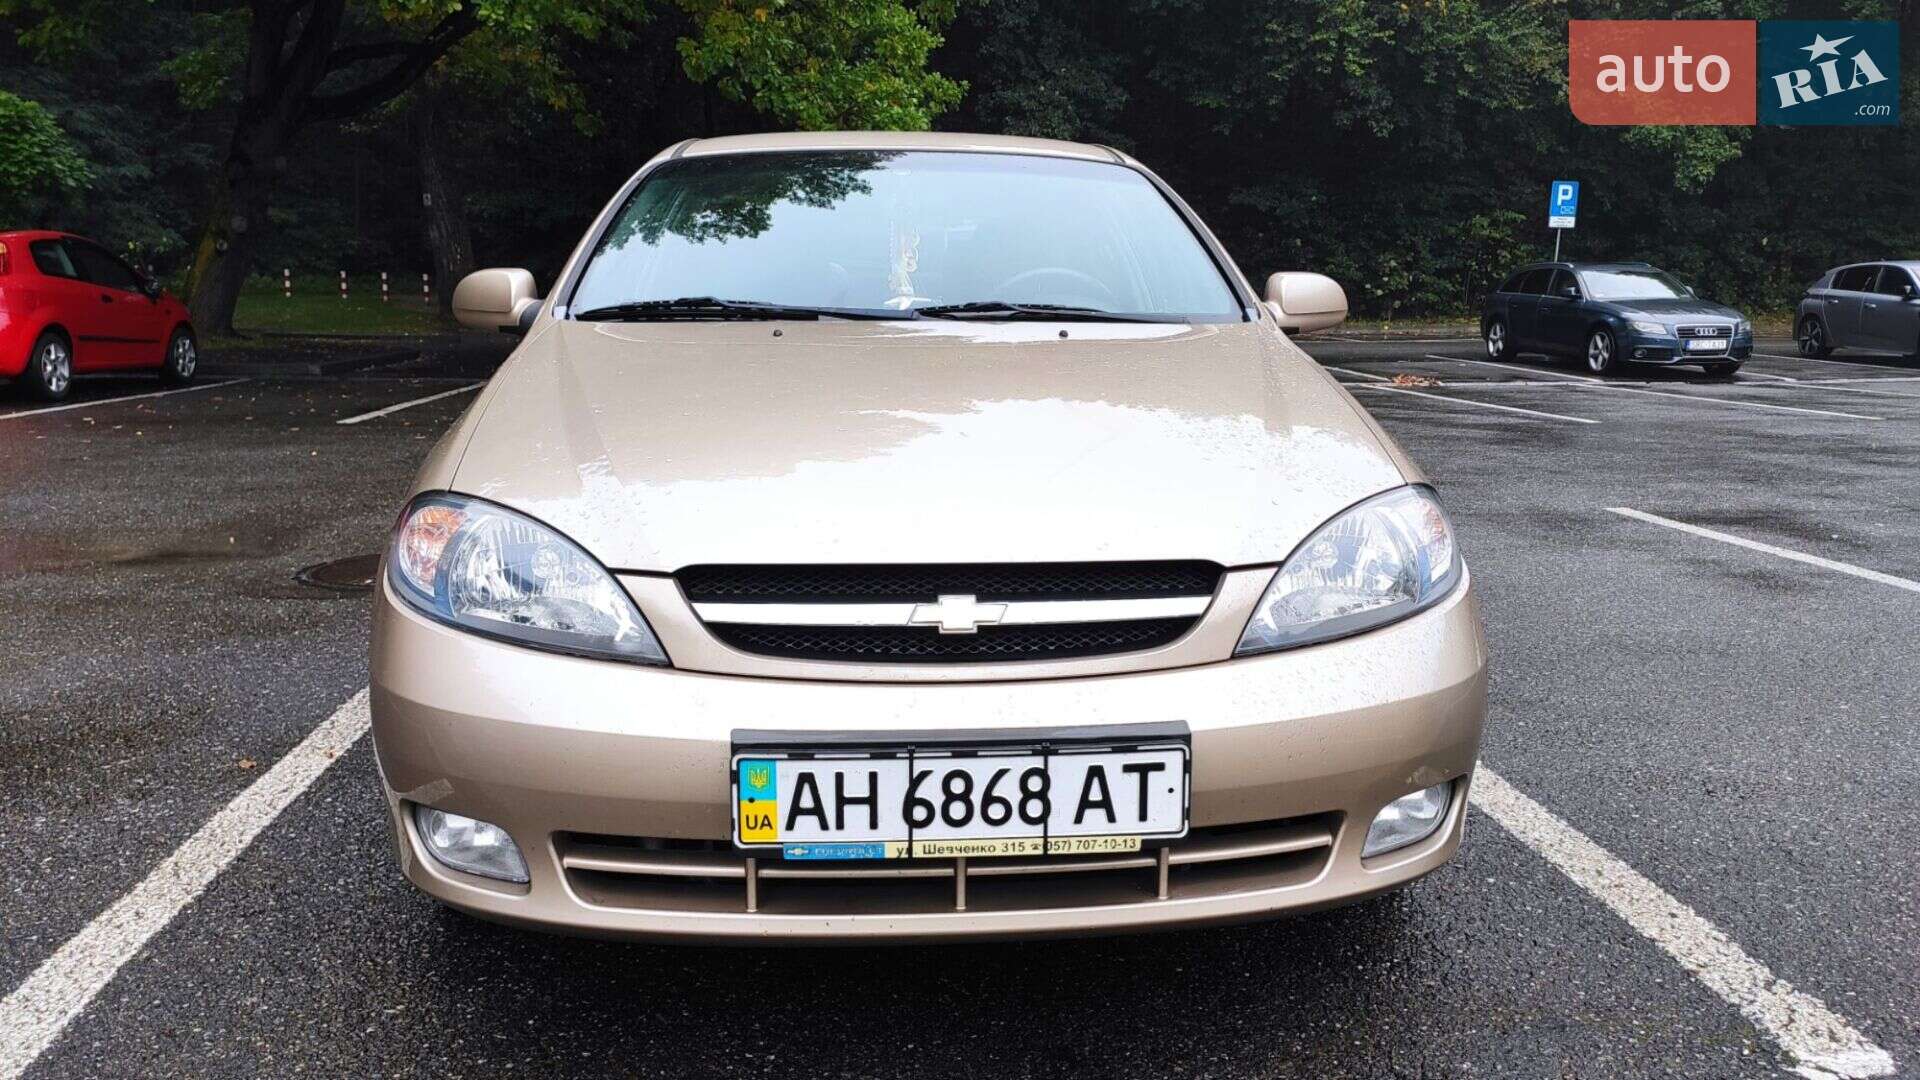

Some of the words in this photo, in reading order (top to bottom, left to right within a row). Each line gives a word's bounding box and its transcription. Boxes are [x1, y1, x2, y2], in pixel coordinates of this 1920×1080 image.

[1557, 184, 1573, 206] P
[785, 771, 878, 831] AH
[903, 767, 1051, 829] 6868
[1073, 762, 1166, 825] AT
[745, 814, 773, 830] UA
[922, 843, 996, 855] Шевченко
[1002, 841, 1026, 853] 315
[1043, 839, 1072, 852] 057)
[1076, 837, 1137, 850] 707-10-13
